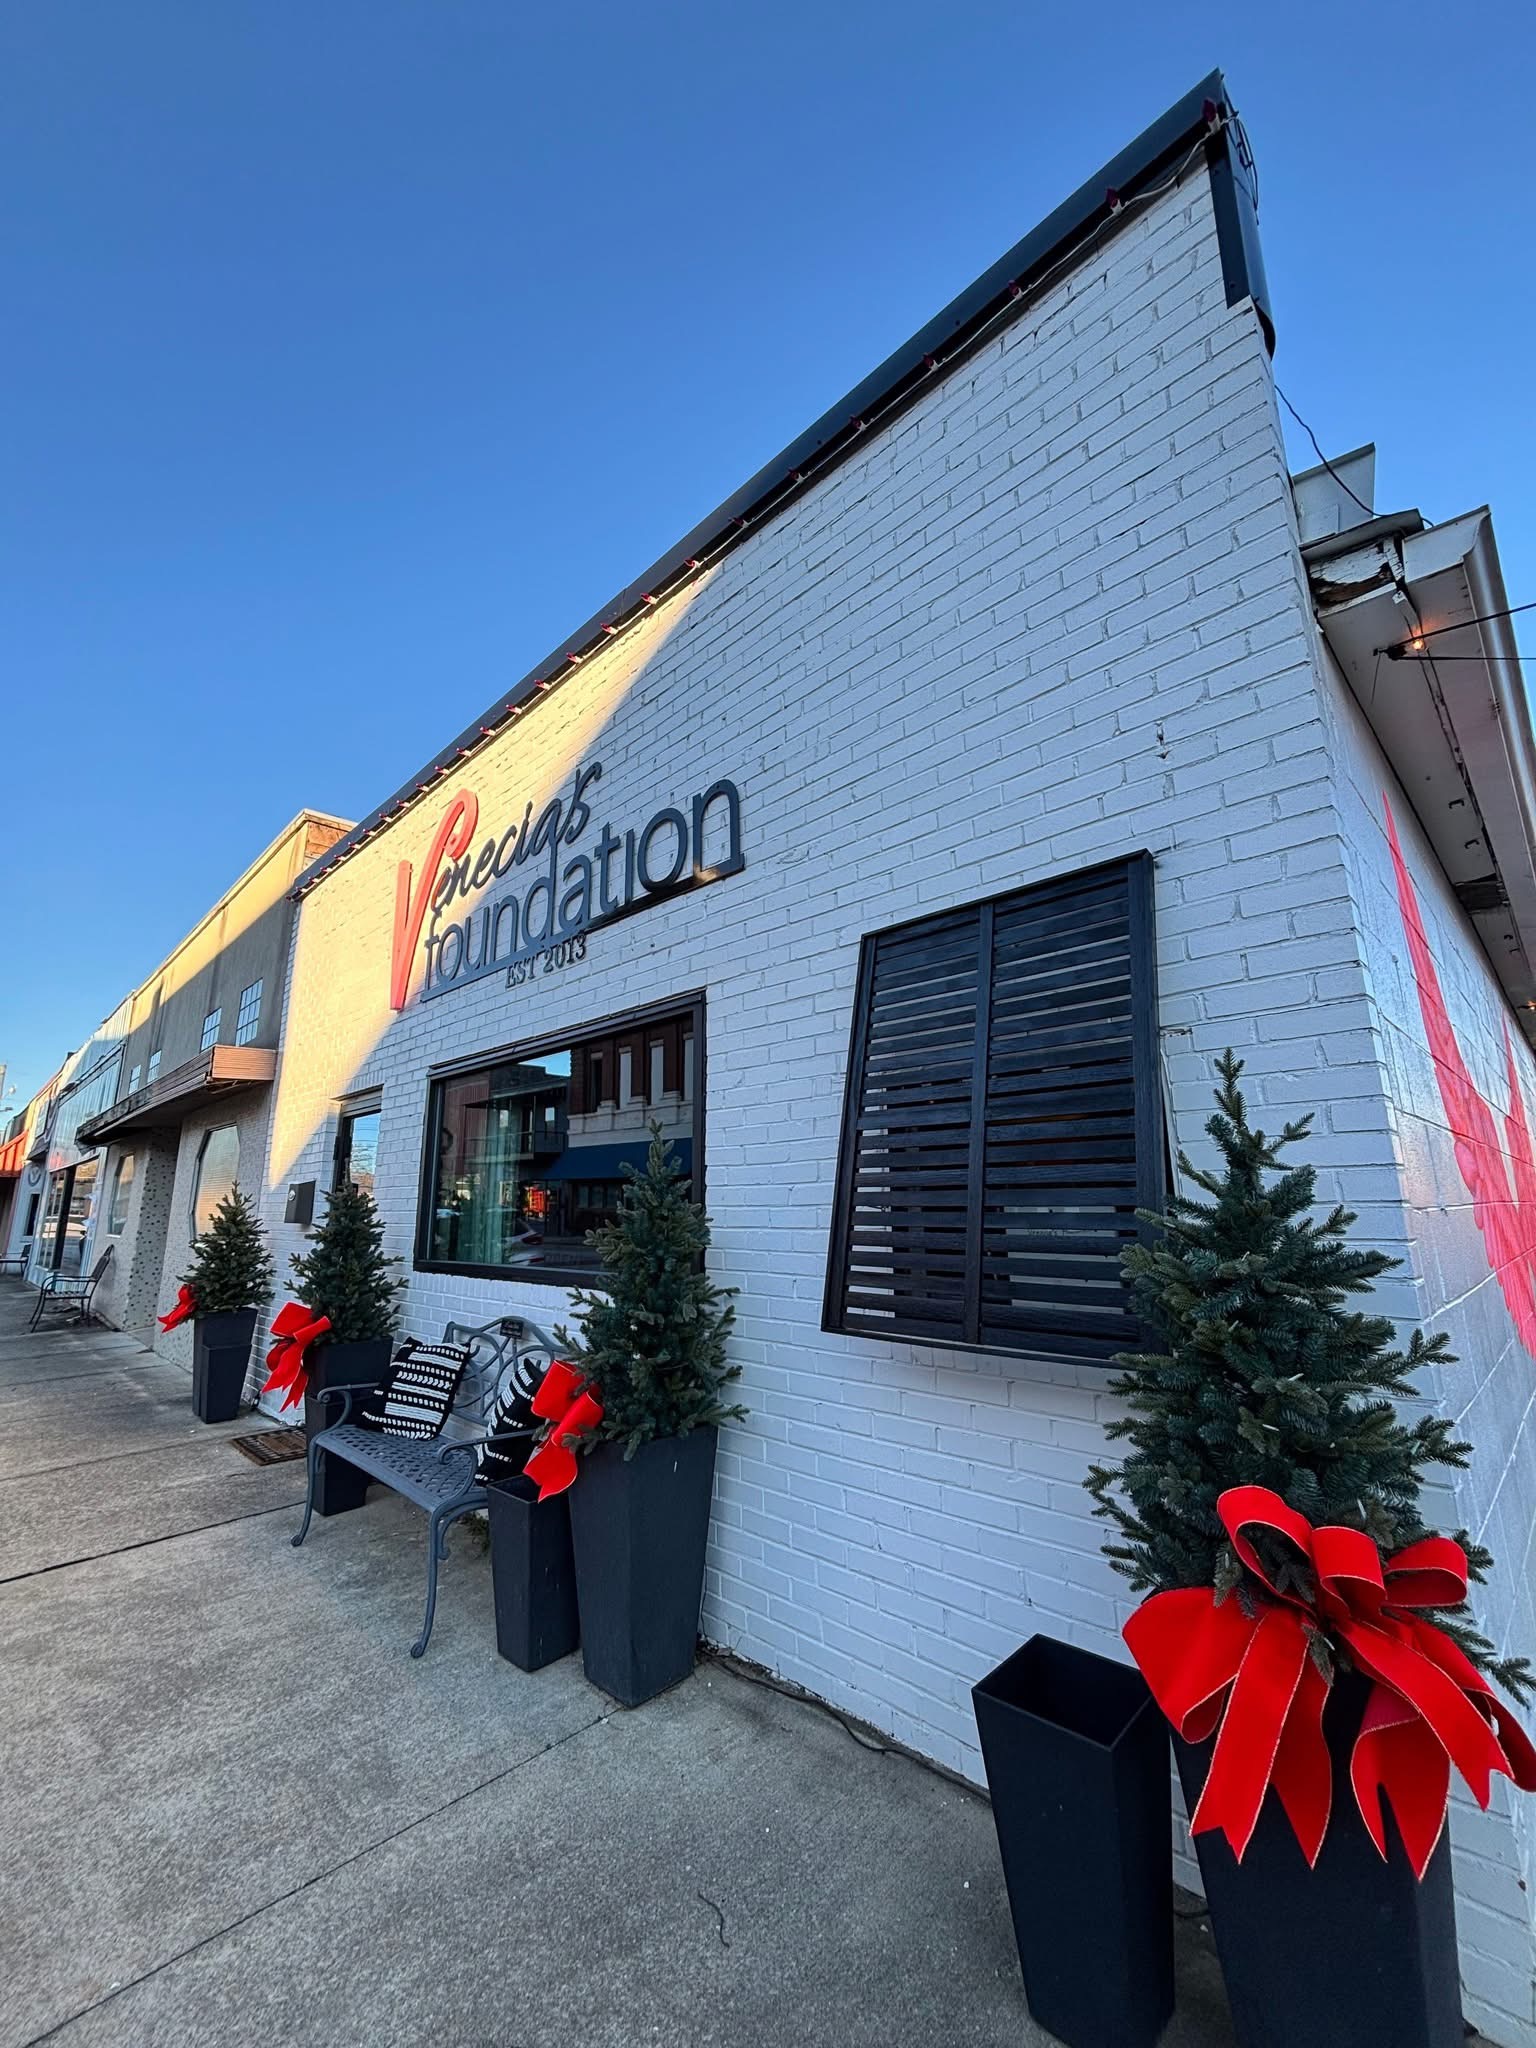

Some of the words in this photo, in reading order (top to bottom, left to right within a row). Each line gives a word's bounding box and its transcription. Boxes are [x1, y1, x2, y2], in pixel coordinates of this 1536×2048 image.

[420, 778, 745, 1002] foundation
[505, 954, 538, 989] EST
[543, 932, 587, 974] 2013
